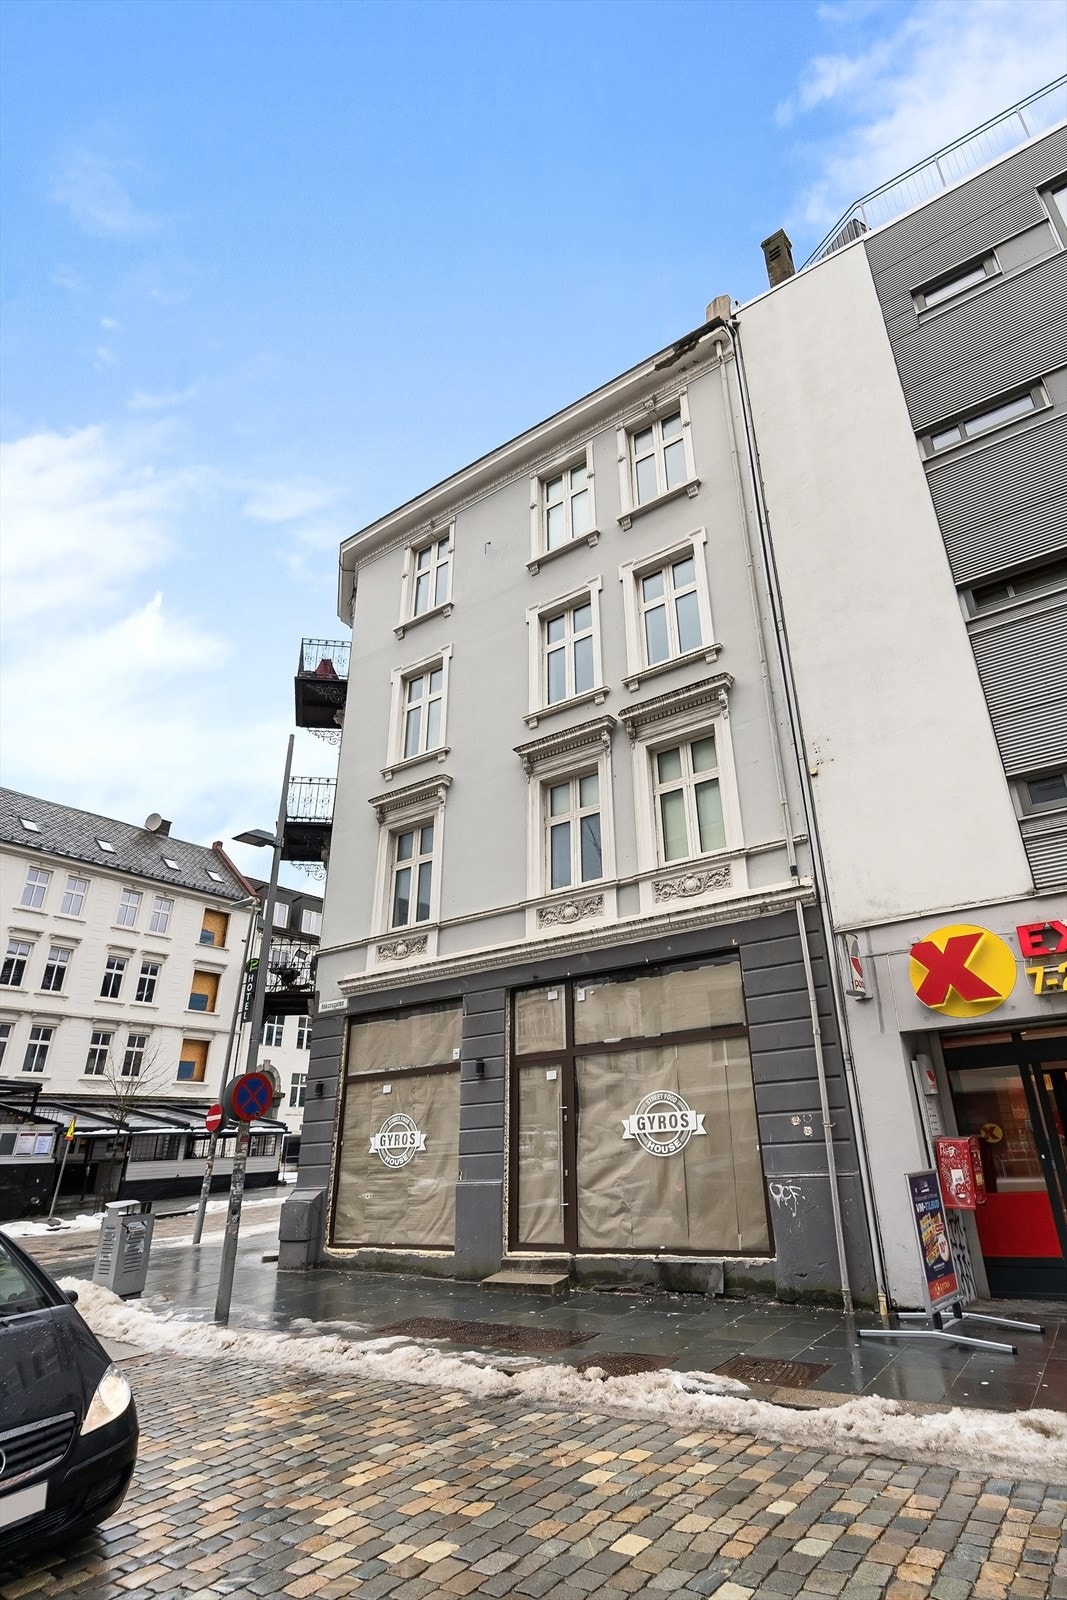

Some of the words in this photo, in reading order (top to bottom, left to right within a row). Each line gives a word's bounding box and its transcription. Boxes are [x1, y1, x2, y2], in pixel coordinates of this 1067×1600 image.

[909, 932, 1002, 1007] X
[243, 973, 254, 1020] HOTEL
[646, 1093, 663, 1105] STREET
[664, 1093, 678, 1103] FOOD
[636, 1113, 689, 1131] GYROS
[380, 1132, 416, 1147] GYROS
[647, 1138, 682, 1154] HOUSE
[385, 1154, 408, 1166] HOUSE
